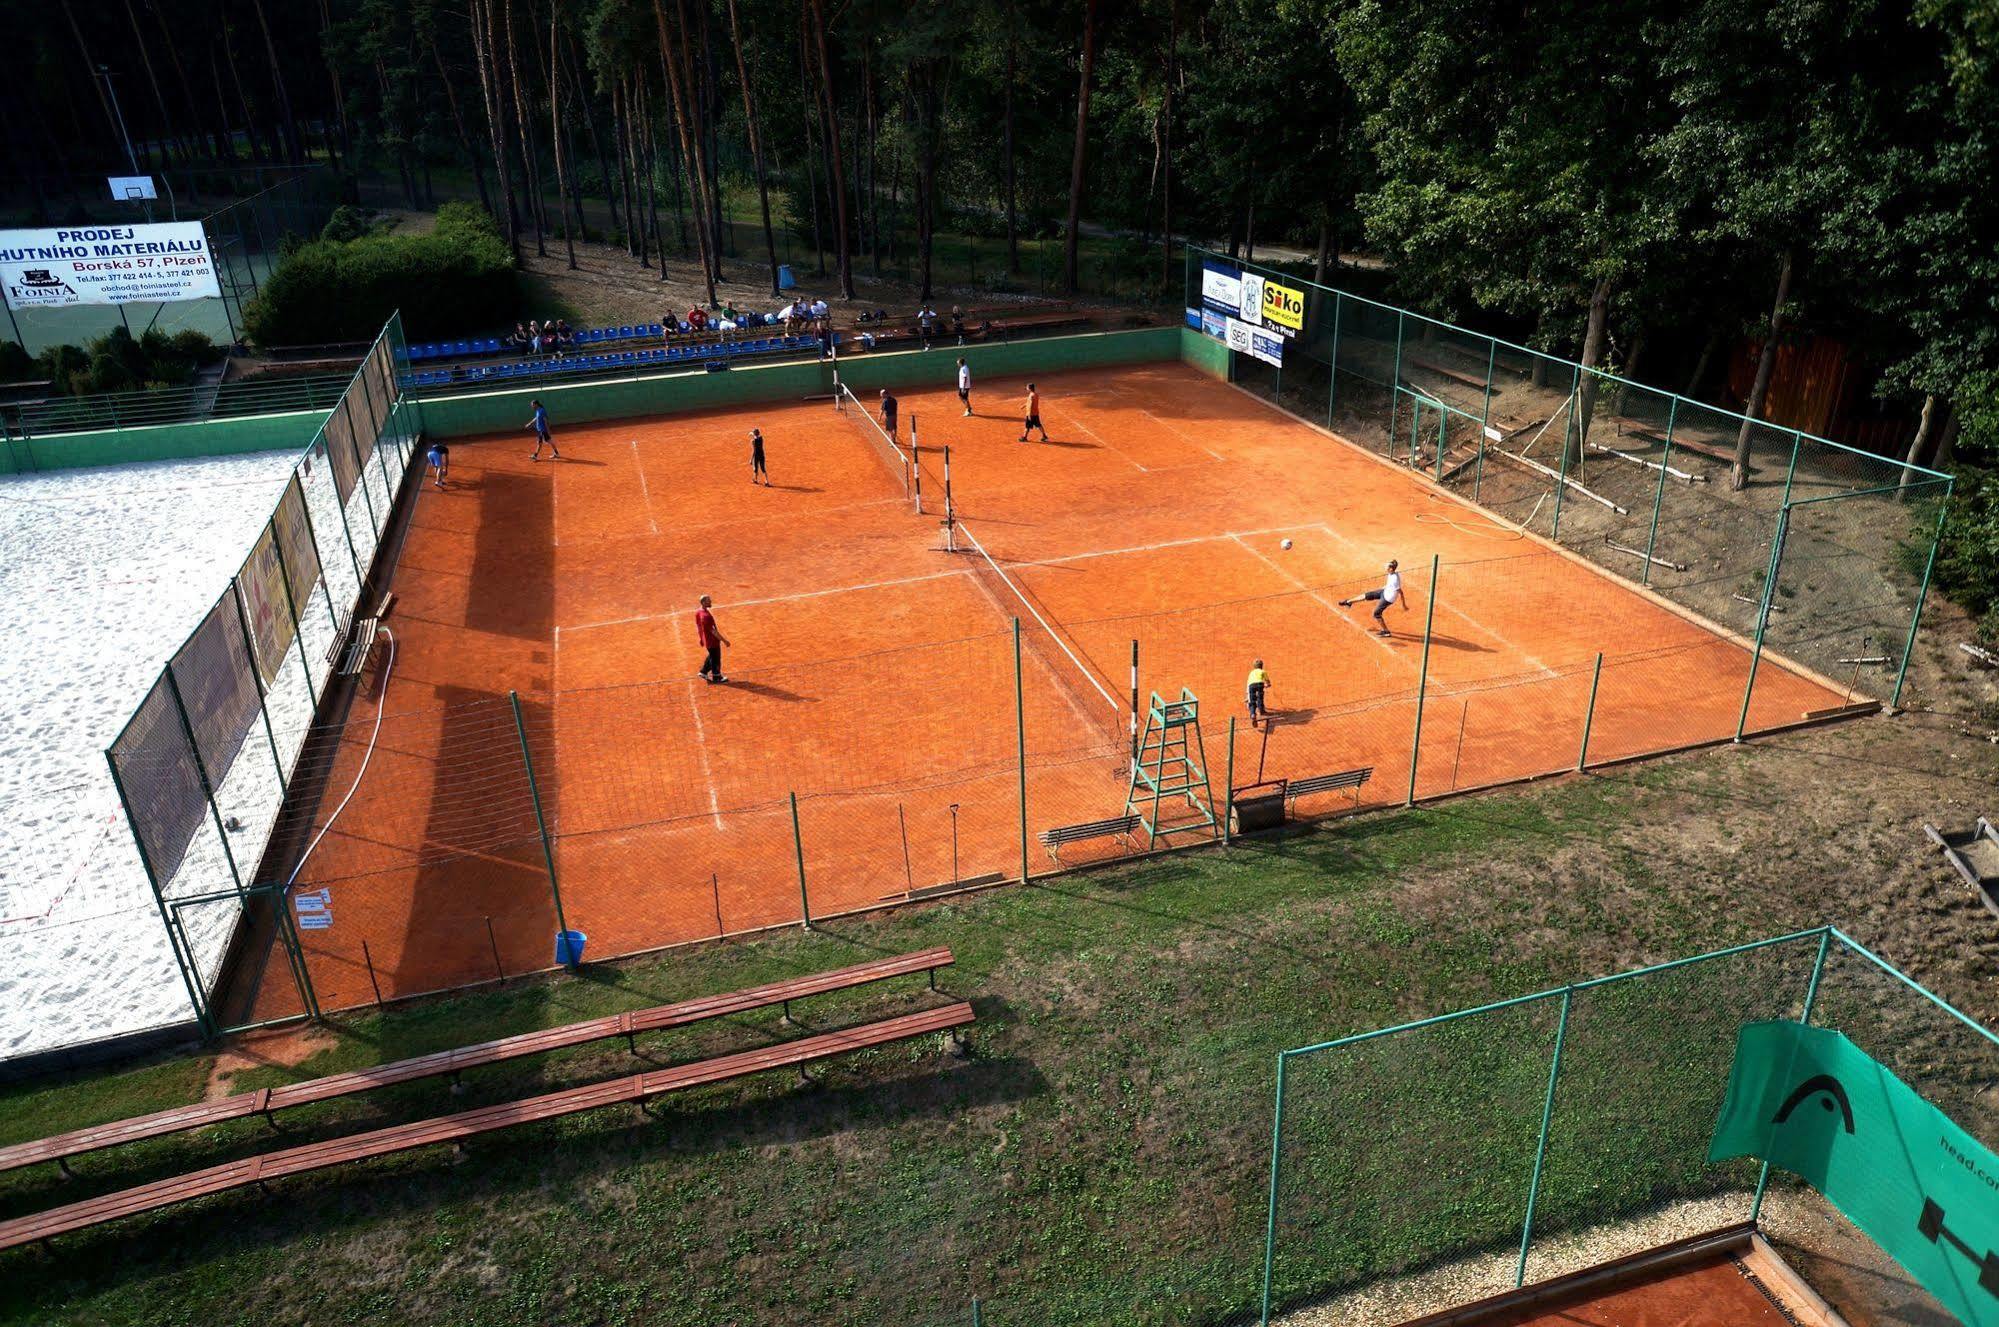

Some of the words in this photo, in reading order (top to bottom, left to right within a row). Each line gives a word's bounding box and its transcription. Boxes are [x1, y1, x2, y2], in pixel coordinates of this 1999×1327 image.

[57, 228, 134, 243] PRODEJ
[0, 245, 88, 261] HUTNÍHO
[94, 239, 202, 257] MATERIÁLU
[73, 260, 132, 271] Borská
[163, 255, 206, 266] Plzeň
[1265, 286, 1301, 314] Siko
[1232, 329, 1247, 345] SEG
[1940, 1135, 1999, 1191] head.co
